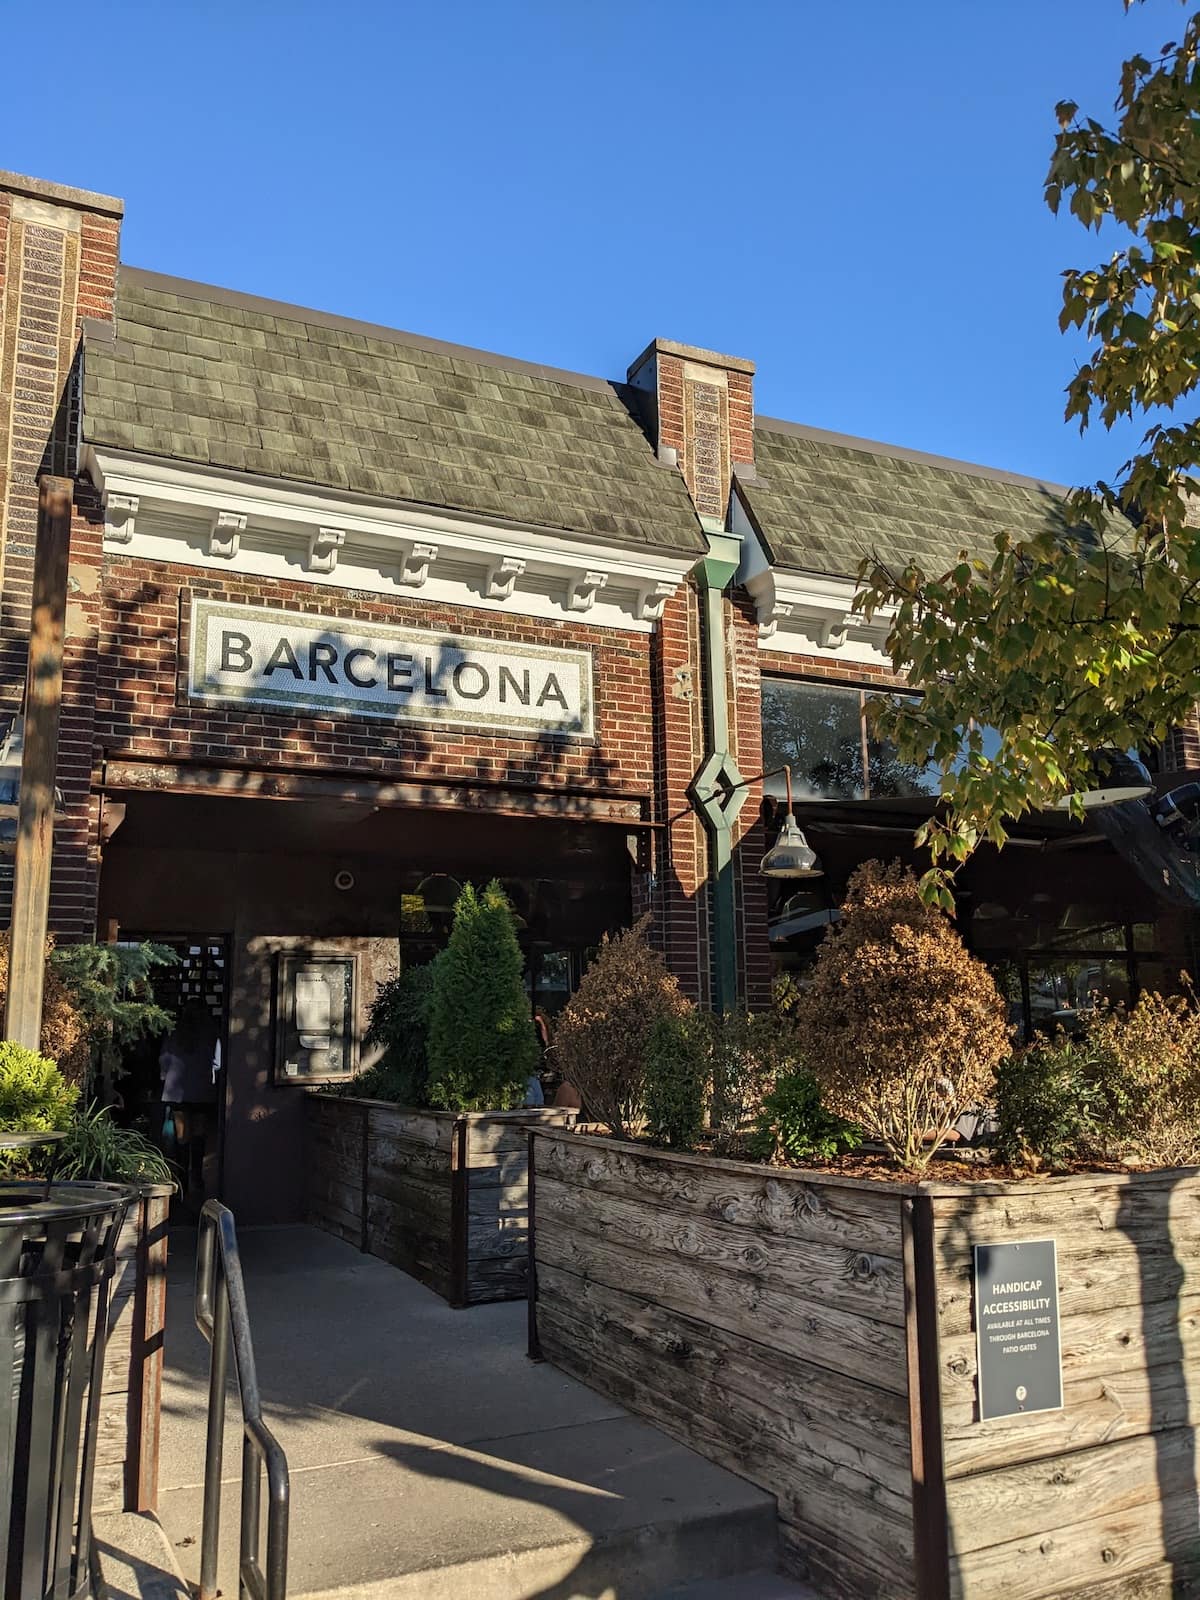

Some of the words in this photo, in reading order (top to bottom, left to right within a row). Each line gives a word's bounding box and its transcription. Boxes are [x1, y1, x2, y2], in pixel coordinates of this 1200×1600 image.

[220, 630, 569, 710] BARCELONA
[992, 1280, 1042, 1295] HANDICAP
[983, 1298, 1050, 1315] ACCESSIBILITY
[987, 1320, 1015, 1330] AVAILABLE
[1034, 1316, 1051, 1324] TIMES
[989, 1334, 1016, 1343] THROUGH
[1017, 1329, 1050, 1339] BARCELONA
[1003, 1346, 1019, 1354] PATIO
[1020, 1344, 1037, 1352] GATES
